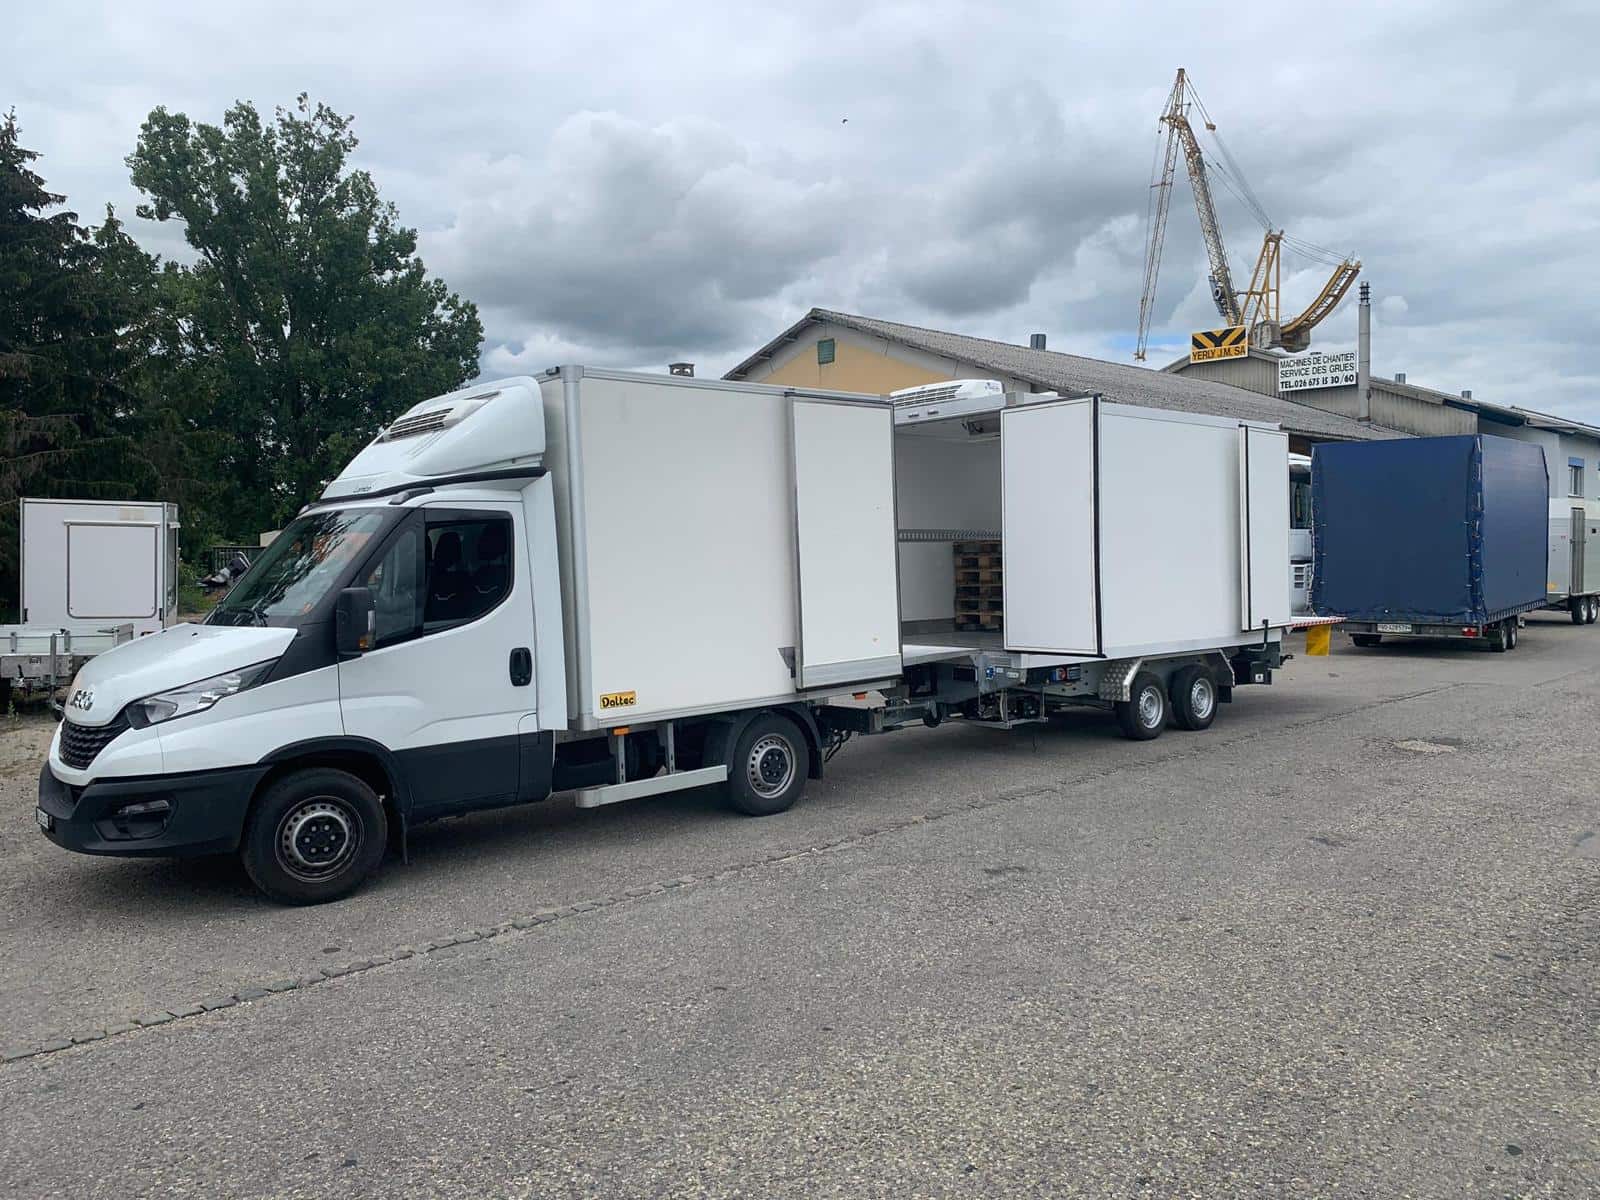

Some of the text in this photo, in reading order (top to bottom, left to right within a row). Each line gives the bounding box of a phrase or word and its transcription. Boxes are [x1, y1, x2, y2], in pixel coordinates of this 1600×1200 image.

[1192, 349, 1215, 361] YERLY
[1234, 344, 1246, 356] SA
[1280, 352, 1355, 368] MACHINES DE CHANTIER
[1280, 362, 1355, 378] SERVICE DES GRUES
[1308, 377, 1320, 387] 675
[1322, 376, 1329, 385] 15
